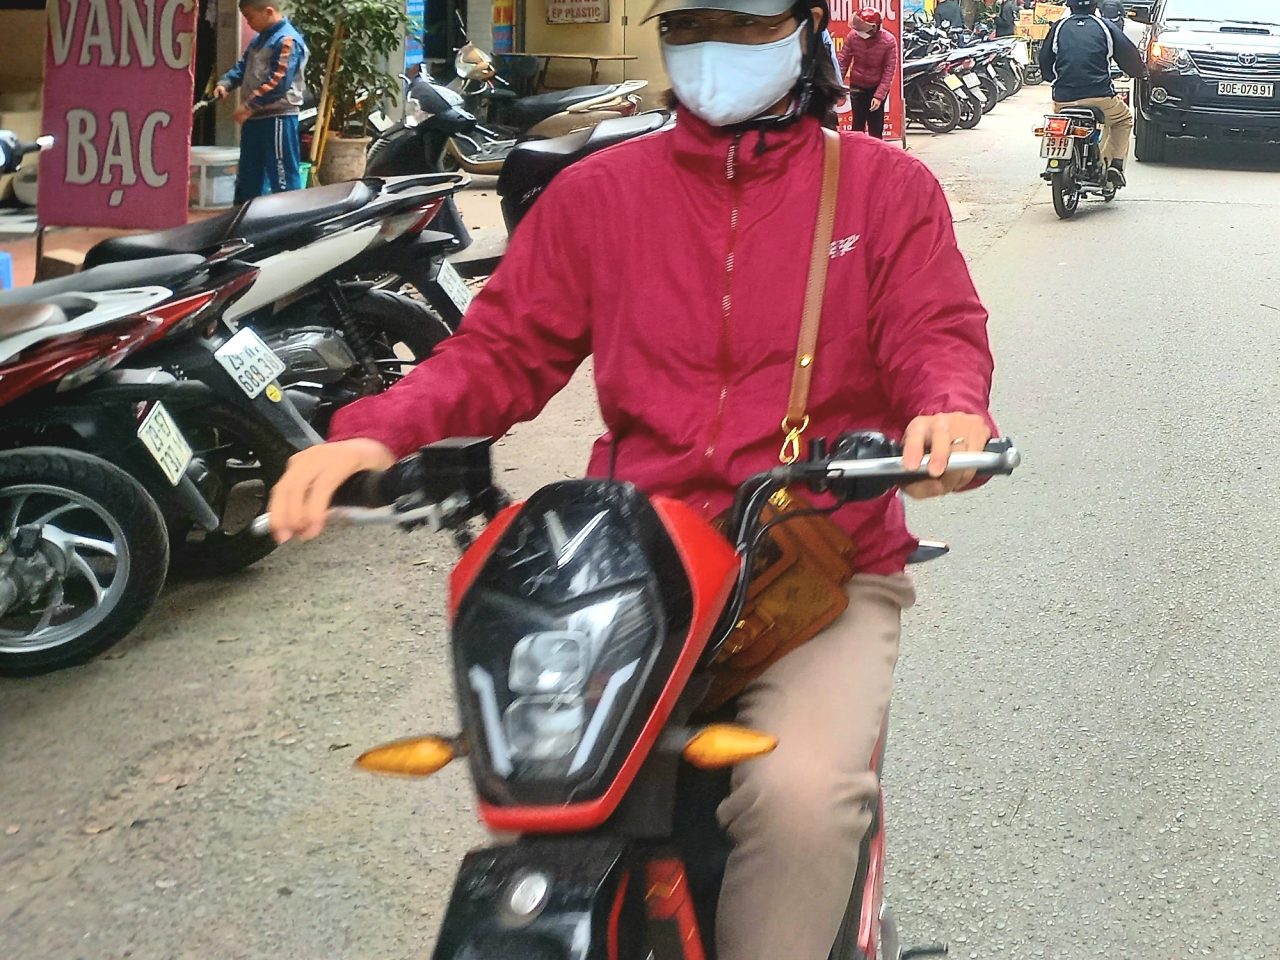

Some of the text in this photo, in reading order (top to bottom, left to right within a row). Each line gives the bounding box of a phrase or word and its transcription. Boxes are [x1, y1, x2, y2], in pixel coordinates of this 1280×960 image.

[565, 6, 600, 19] PLASTIC
[1220, 83, 1271, 96] 30E-079.91
[65, 108, 171, 207] BẠC
[1046, 147, 1067, 157] 1777
